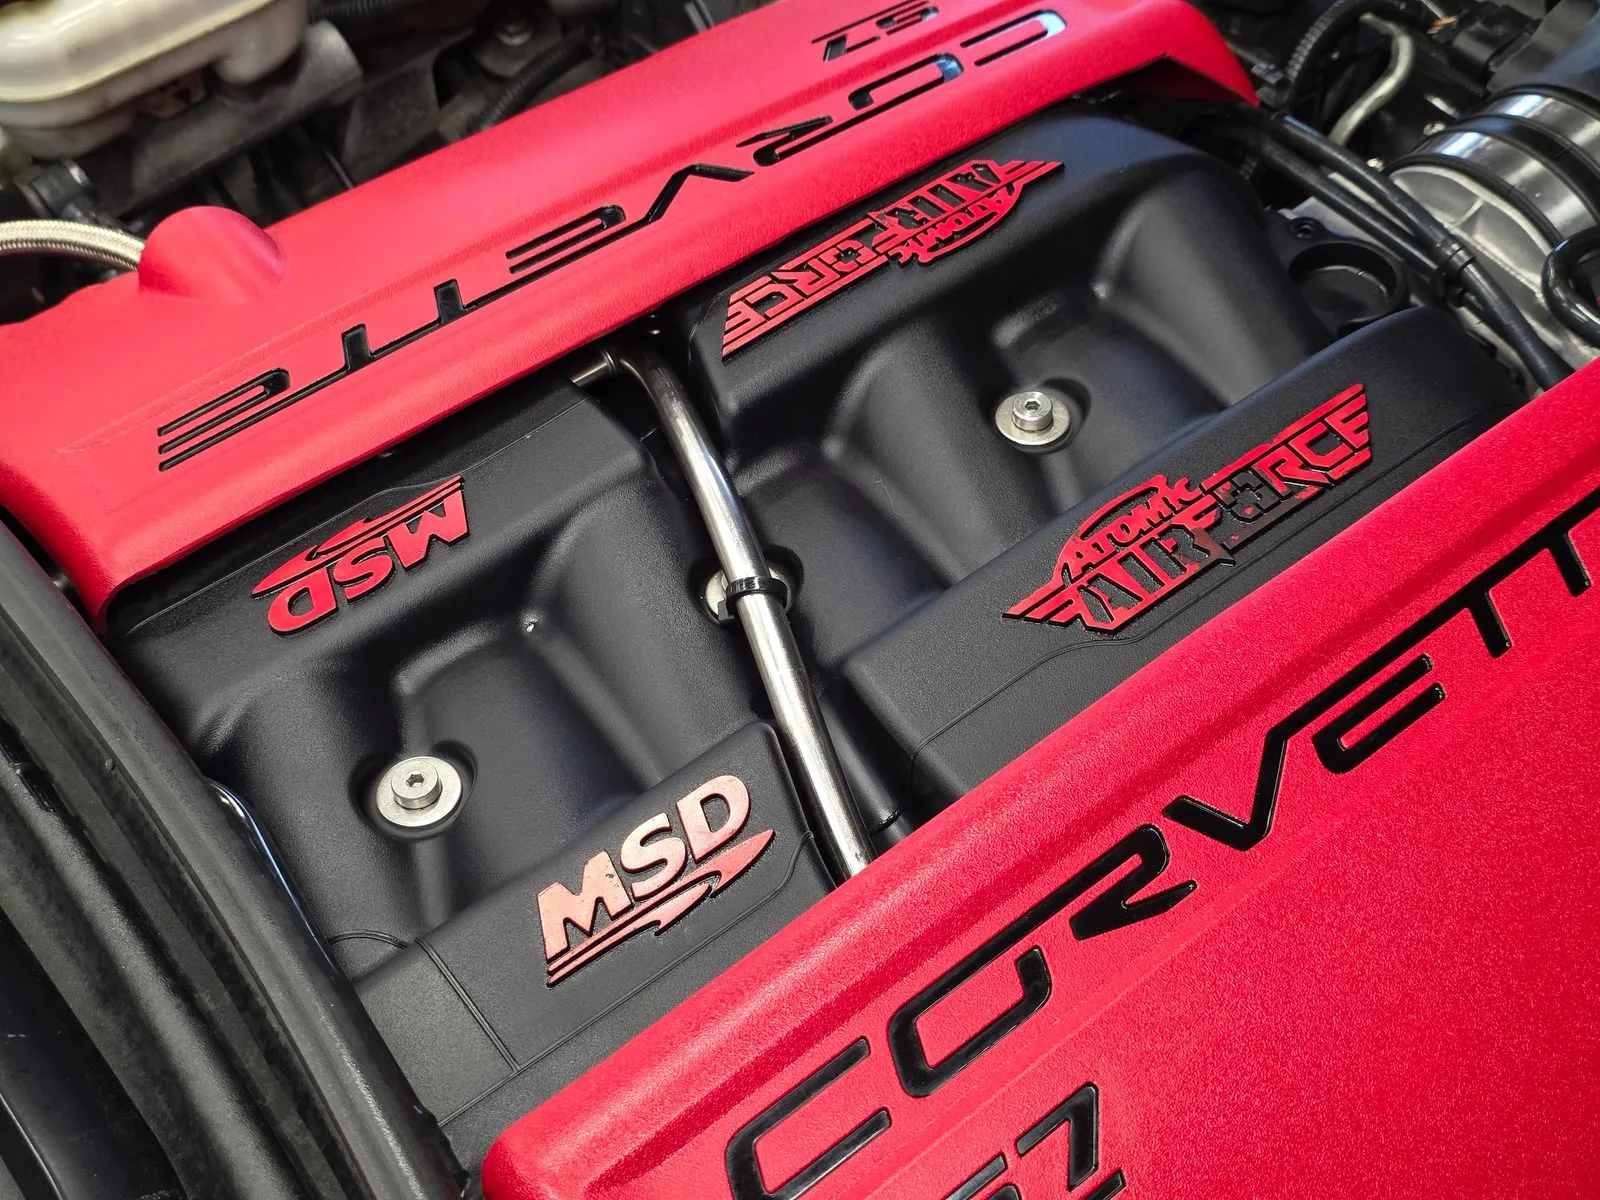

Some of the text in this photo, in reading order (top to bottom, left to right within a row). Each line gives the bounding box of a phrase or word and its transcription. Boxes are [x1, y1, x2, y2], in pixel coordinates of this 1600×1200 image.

[157, 9, 1067, 471] CORVETTE
[267, 489, 470, 634] MSD
[536, 774, 752, 964] MSD
[725, 487, 1600, 1200] CORVETT
